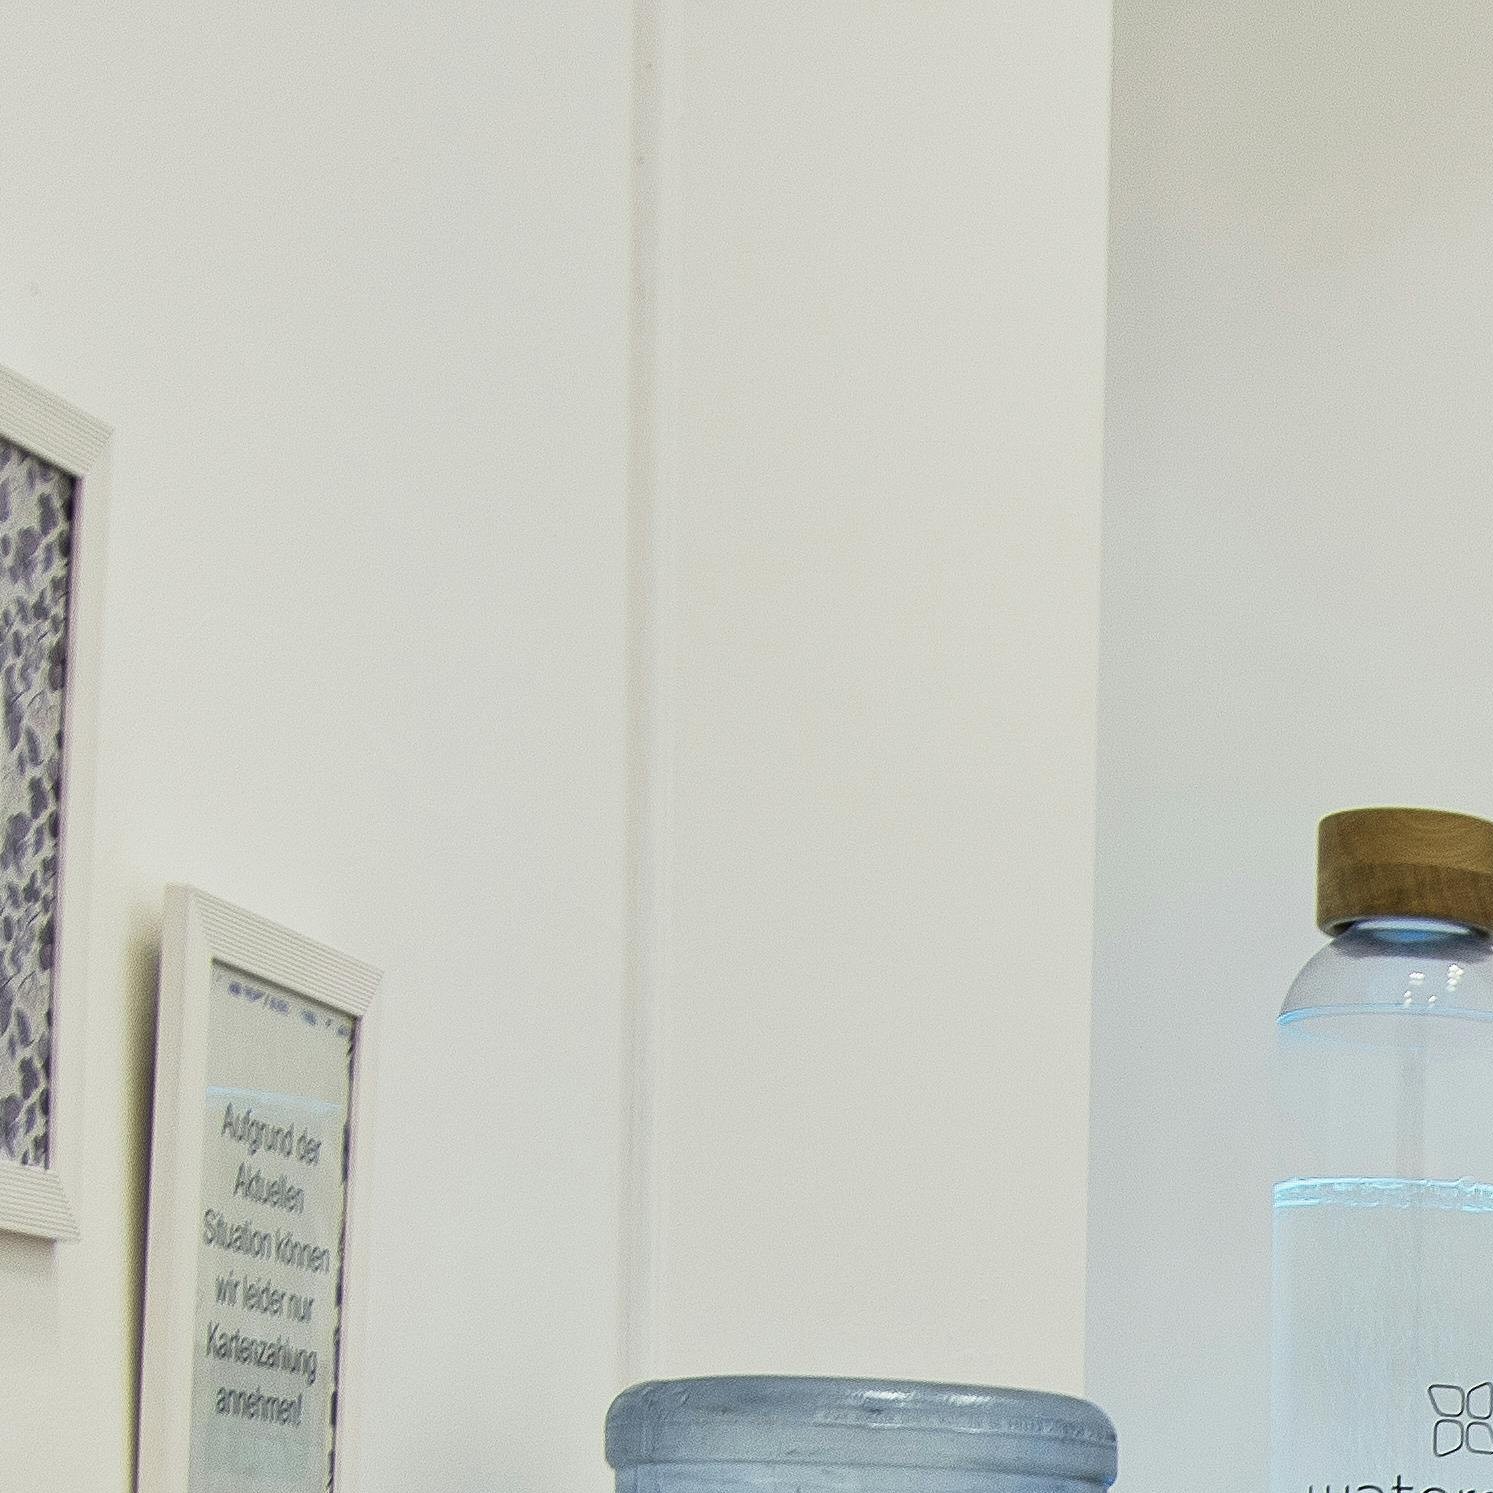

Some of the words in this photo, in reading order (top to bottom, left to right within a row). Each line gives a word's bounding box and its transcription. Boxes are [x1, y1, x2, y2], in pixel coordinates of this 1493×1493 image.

[221, 1102, 294, 1157] Aufgrund
[296, 1127, 322, 1167] der
[233, 1161, 304, 1215] Aktuellen
[203, 1208, 272, 1261] Situation
[274, 1227, 330, 1274] können
[216, 1270, 239, 1307] wir
[243, 1275, 286, 1315] leider
[287, 1294, 314, 1323] nur
[206, 1320, 318, 1388] Kartenzahlung
[216, 1386, 303, 1428] annehmen!
